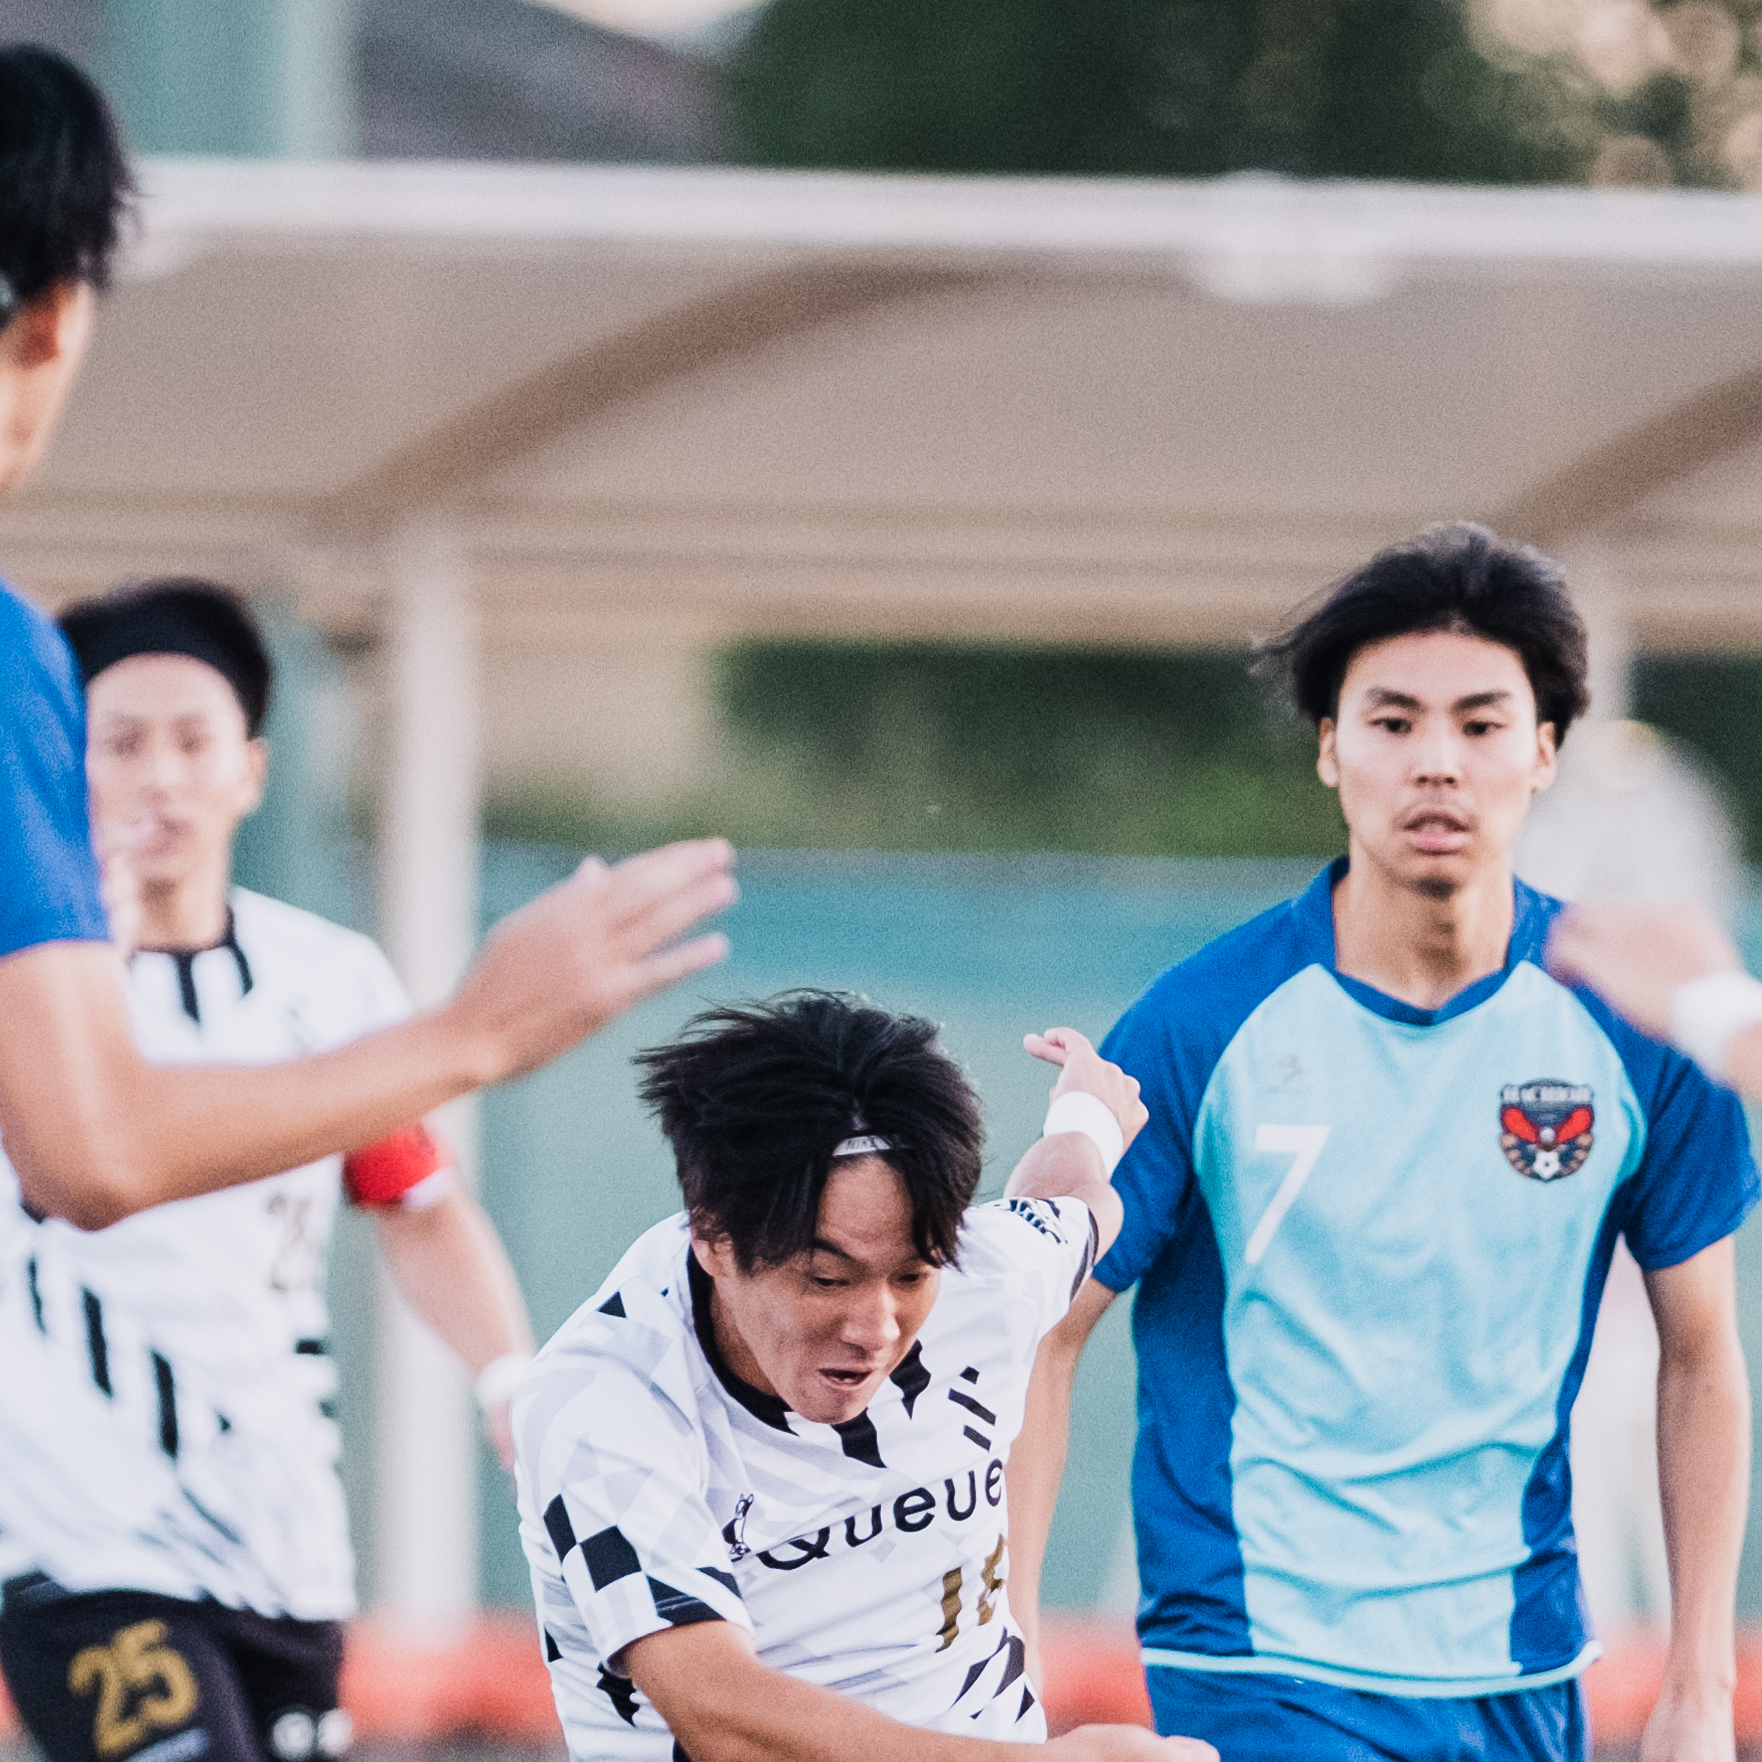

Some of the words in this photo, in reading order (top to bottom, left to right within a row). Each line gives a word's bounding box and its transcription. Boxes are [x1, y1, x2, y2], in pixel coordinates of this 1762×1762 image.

[1244, 1122, 1331, 1264] 7
[756, 1458, 1004, 1571] Queue
[68, 1619, 198, 1758] 25
